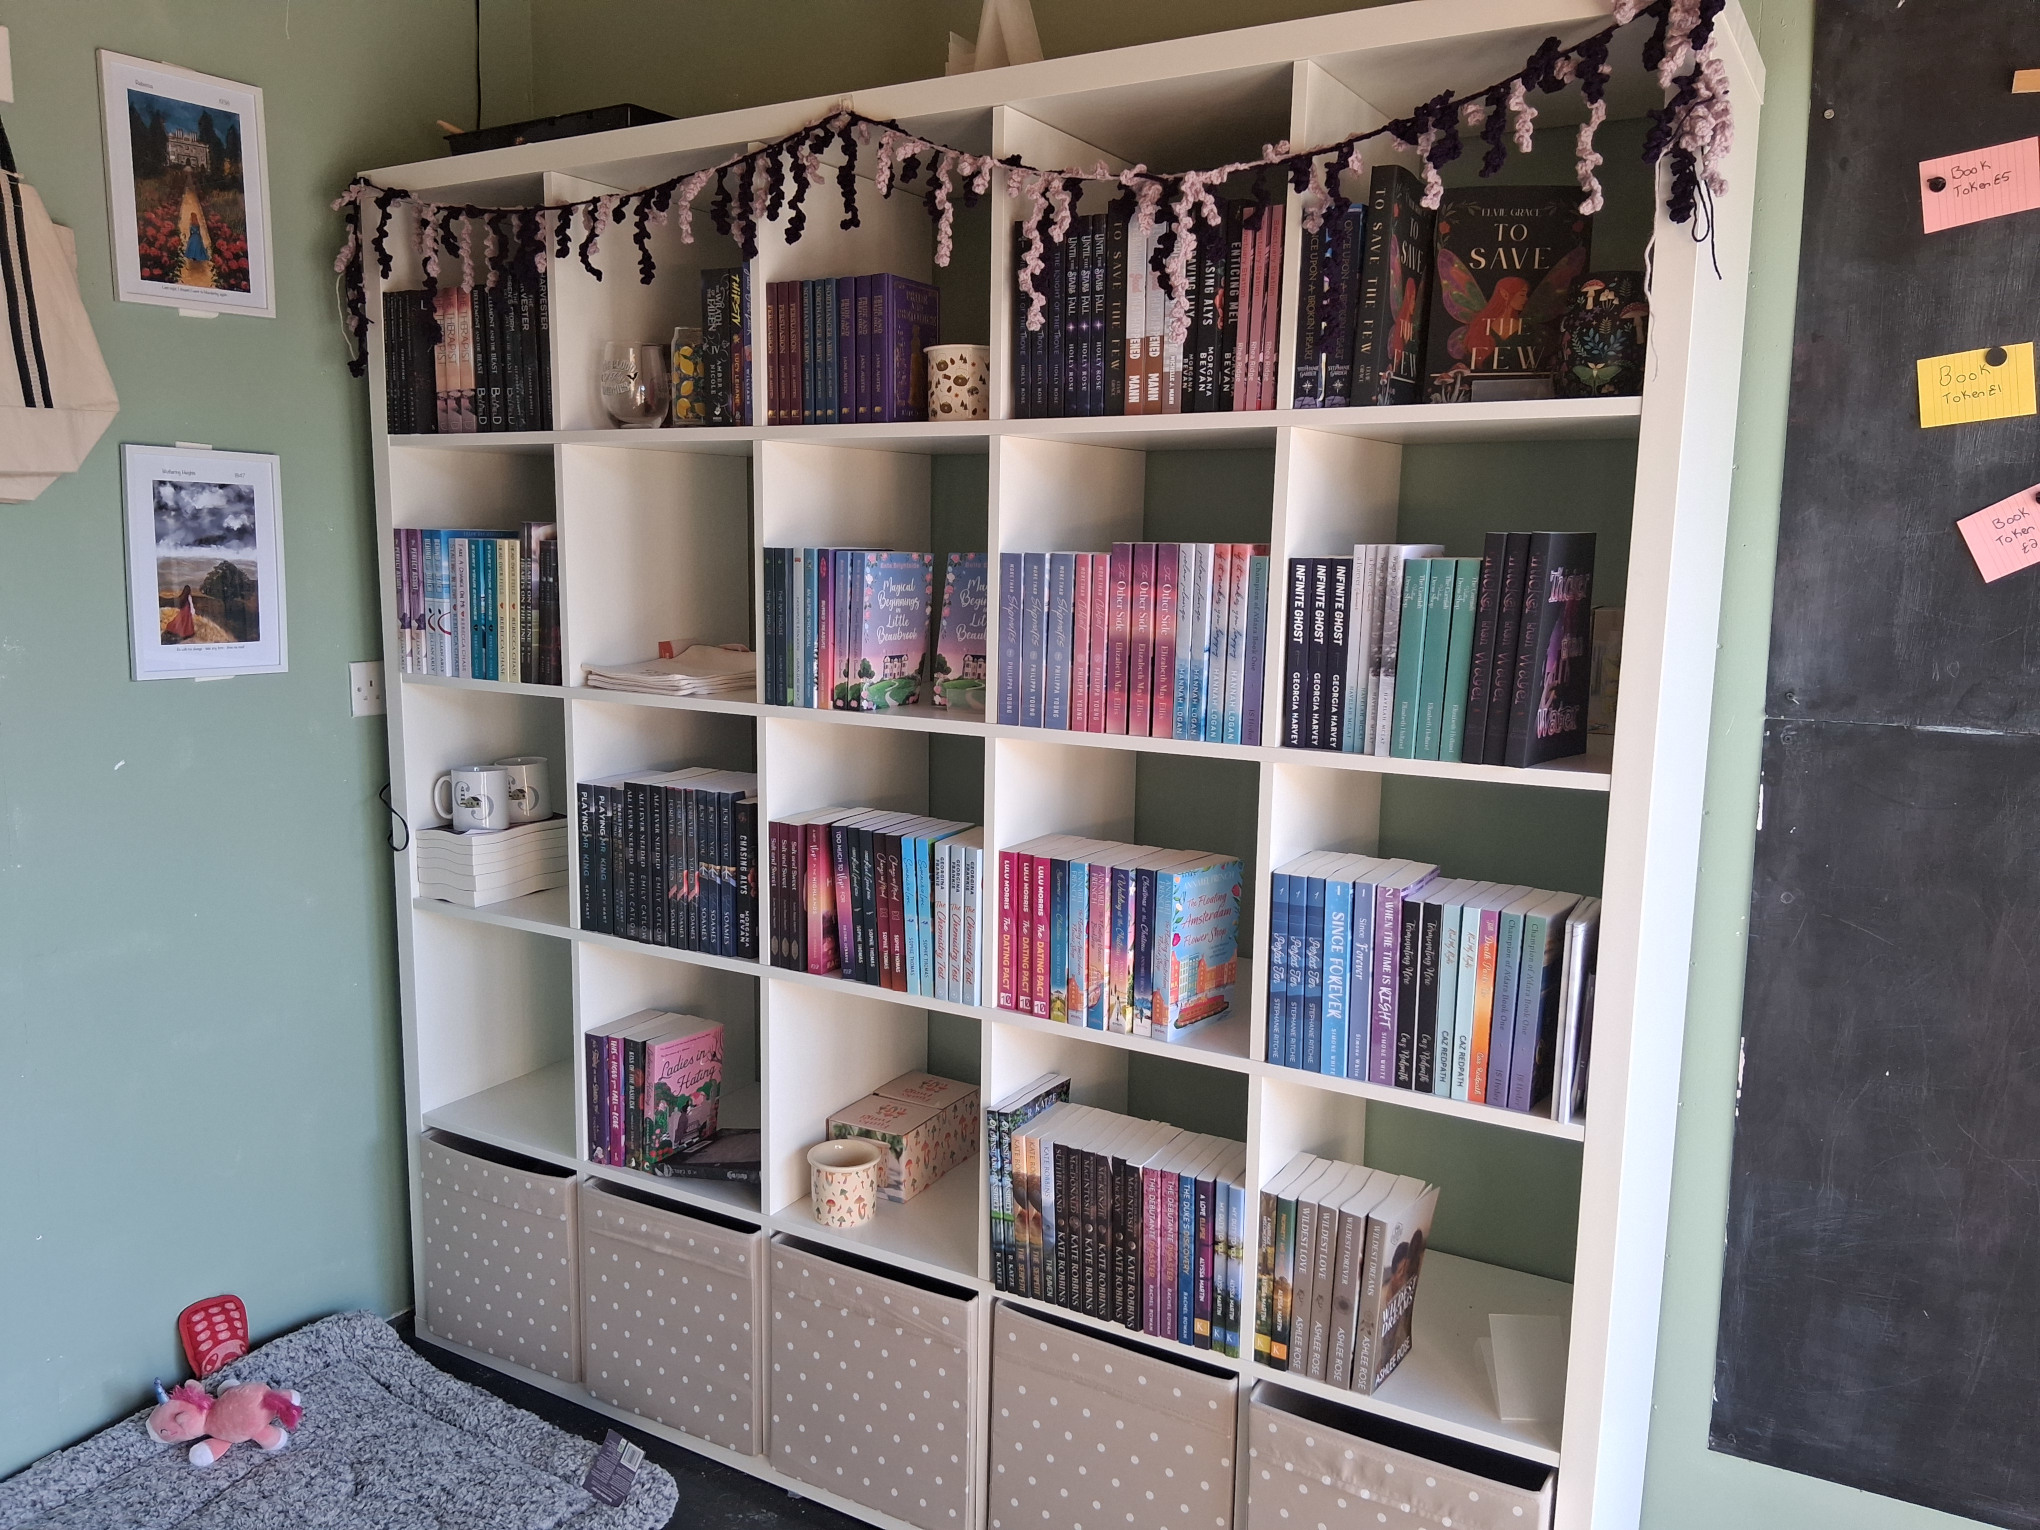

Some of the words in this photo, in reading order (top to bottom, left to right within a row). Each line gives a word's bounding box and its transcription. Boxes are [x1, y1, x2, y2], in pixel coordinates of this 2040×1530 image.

[1951, 161, 1992, 180] Book
[1953, 182, 1991, 198] Token
[1994, 171, 2012, 186] £5
[1374, 187, 1386, 210] TO
[1510, 208, 1541, 217] GRACE
[1370, 222, 1382, 265] SAVE
[1494, 223, 1528, 241] TO
[1094, 234, 1105, 258] UNTIL
[1469, 247, 1551, 270] SAVE
[1094, 268, 1105, 292] STARS
[1229, 242, 1241, 297] ENTICING
[1269, 267, 1277, 297] Station
[1095, 294, 1104, 314] FALL
[1366, 276, 1378, 309] THE
[1203, 299, 1216, 326] ALYS
[1228, 302, 1240, 324] MEL
[446, 311, 458, 365] THERAPIST
[1361, 319, 1373, 355] FEW
[1482, 317, 1531, 336] THE
[1205, 346, 1214, 397] MORGANA
[1262, 361, 1271, 382] Ridge
[1470, 346, 1546, 370] FEW
[1198, 352, 1207, 392] BEVAN
[1940, 364, 1991, 386] Book
[1129, 375, 1140, 403] MANN
[1943, 391, 1985, 404] Token
[1989, 384, 2002, 397] £1
[1992, 508, 2030, 530] Book
[1995, 526, 2036, 546] Token
[2022, 538, 2038, 554] £2
[526, 591, 532, 602] ON
[884, 577, 916, 597] Magical
[1160, 584, 1172, 612] Other
[1314, 564, 1327, 609] INFINITE
[1334, 566, 1346, 610] INFINITE
[878, 590, 920, 611] Beginnings
[886, 614, 910, 628] Little
[1053, 596, 1068, 647] Shipmates
[1160, 614, 1171, 636] Side
[1314, 610, 1325, 645] GHOST
[1332, 610, 1344, 646] GHOST
[876, 625, 918, 645] Beaubrook
[1160, 646, 1169, 682] Elizabeth
[1052, 664, 1060, 694] PHILIPPA
[1158, 684, 1168, 700] May
[1228, 670, 1238, 708] HANNAH
[1311, 672, 1321, 712] GEORGIA
[1052, 697, 1060, 718] YOUNG
[1330, 674, 1340, 714] GEORGIA
[1159, 702, 1167, 720] Ellis
[1227, 711, 1237, 740] LOGAN
[1310, 714, 1320, 746] HARVEY
[1330, 716, 1340, 748] HARVEY
[581, 792, 589, 832] PLAYING
[1187, 898, 1197, 908] The
[1198, 892, 1228, 909] Floating
[1386, 886, 1394, 898] 2
[1182, 908, 1232, 929] Amsterdam
[1358, 918, 1368, 938] Since
[1384, 901, 1394, 929] WHEN
[964, 916, 976, 966] Chemistry
[1037, 924, 1045, 938] The
[1184, 934, 1207, 946] Flower
[1208, 926, 1228, 943] Shop
[1330, 912, 1346, 952] SINCE
[1382, 930, 1394, 950] THE
[1424, 922, 1438, 966] Terminating
[1271, 933, 1286, 966] Perfect
[1354, 942, 1370, 981] Forever
[1382, 951, 1393, 974] TIME
[966, 966, 975, 985] Test
[1036, 976, 1044, 998] PACT
[1274, 966, 1286, 984] Ten
[1328, 957, 1344, 1018] FOREVER
[1382, 975, 1392, 984] IS
[1424, 967, 1435, 986] Here
[1272, 998, 1282, 1032] STEPHANIE
[1376, 986, 1392, 1030] RIGHT
[1380, 1032, 1388, 1058] SIMONE
[1418, 1032, 1432, 1047] Caz
[1458, 1035, 1468, 1050] CAZ
[658, 1055, 694, 1082] Ladies
[696, 1050, 707, 1061] in
[1378, 1060, 1388, 1081] WHITE
[1419, 1050, 1431, 1082] Redpath
[1457, 1050, 1467, 1088] REDPATH
[672, 1066, 716, 1096] Hating
[1148, 1177, 1157, 1192] THE
[1182, 1184, 1190, 1198] THE
[1148, 1194, 1156, 1239] DEBUTANTE
[1182, 1200, 1190, 1230] DUKE'S
[1056, 1230, 1066, 1257] KATE
[1320, 1212, 1330, 1252] WILDEST
[1343, 1217, 1354, 1248] WILDEST
[1370, 1225, 1382, 1260] WILDEST
[1148, 1240, 1156, 1278] DISASTER
[1182, 1230, 1190, 1275] DISCOVERY
[1057, 1259, 1066, 1302] ROBBINS
[1126, 1254, 1136, 1282] KATE
[1318, 1254, 1328, 1280] LOVE
[1341, 1250, 1351, 1285] FOREVER
[1366, 1262, 1378, 1297] DREAMS
[1126, 1284, 1136, 1328] ROBBINS
[1312, 1320, 1323, 1351] ASHLEE
[1336, 1327, 1346, 1358] ASHLEE
[1311, 1352, 1322, 1376] ROSE
[1360, 1335, 1370, 1366] ASHLEE
[1333, 1358, 1344, 1382] ROSE
[1358, 1366, 1368, 1390] ROSE
